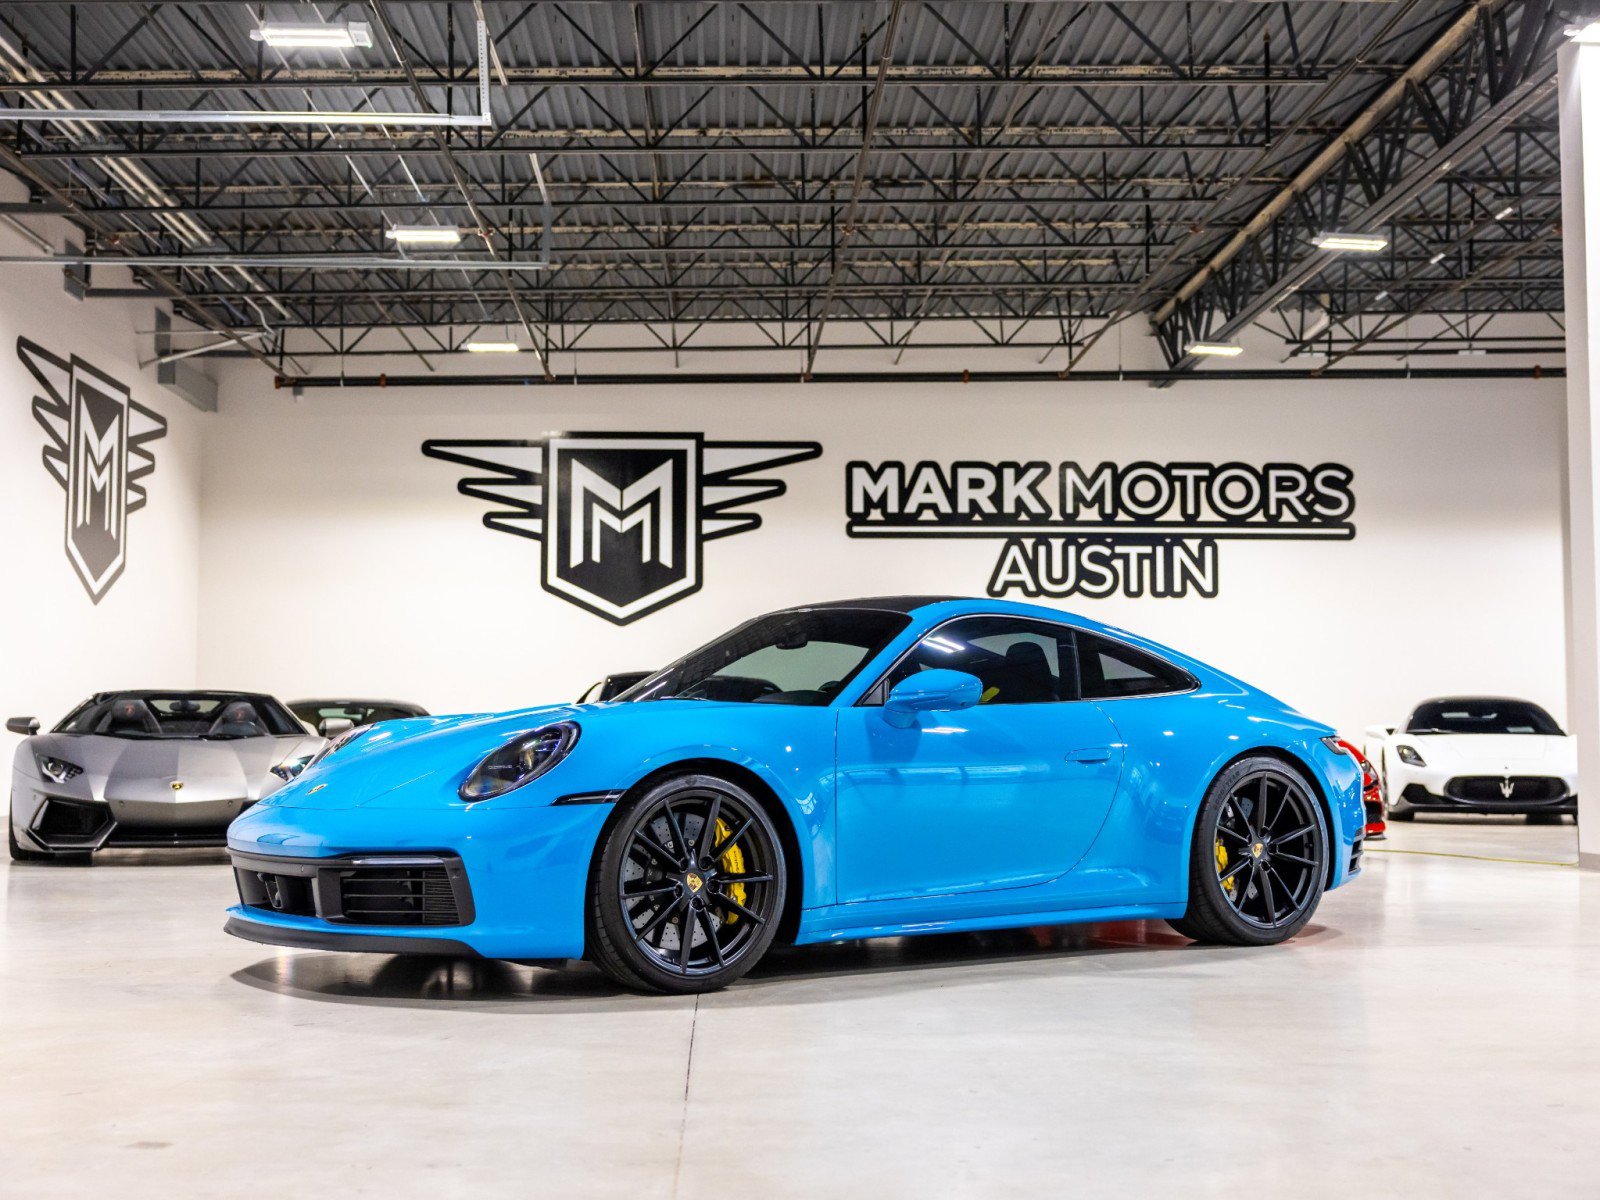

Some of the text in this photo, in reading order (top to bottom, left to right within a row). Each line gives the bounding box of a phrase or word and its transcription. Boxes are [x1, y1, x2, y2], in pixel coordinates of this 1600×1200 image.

[849, 464, 1351, 518] MARK MOTORS
[990, 541, 1216, 595] AUSTIN
